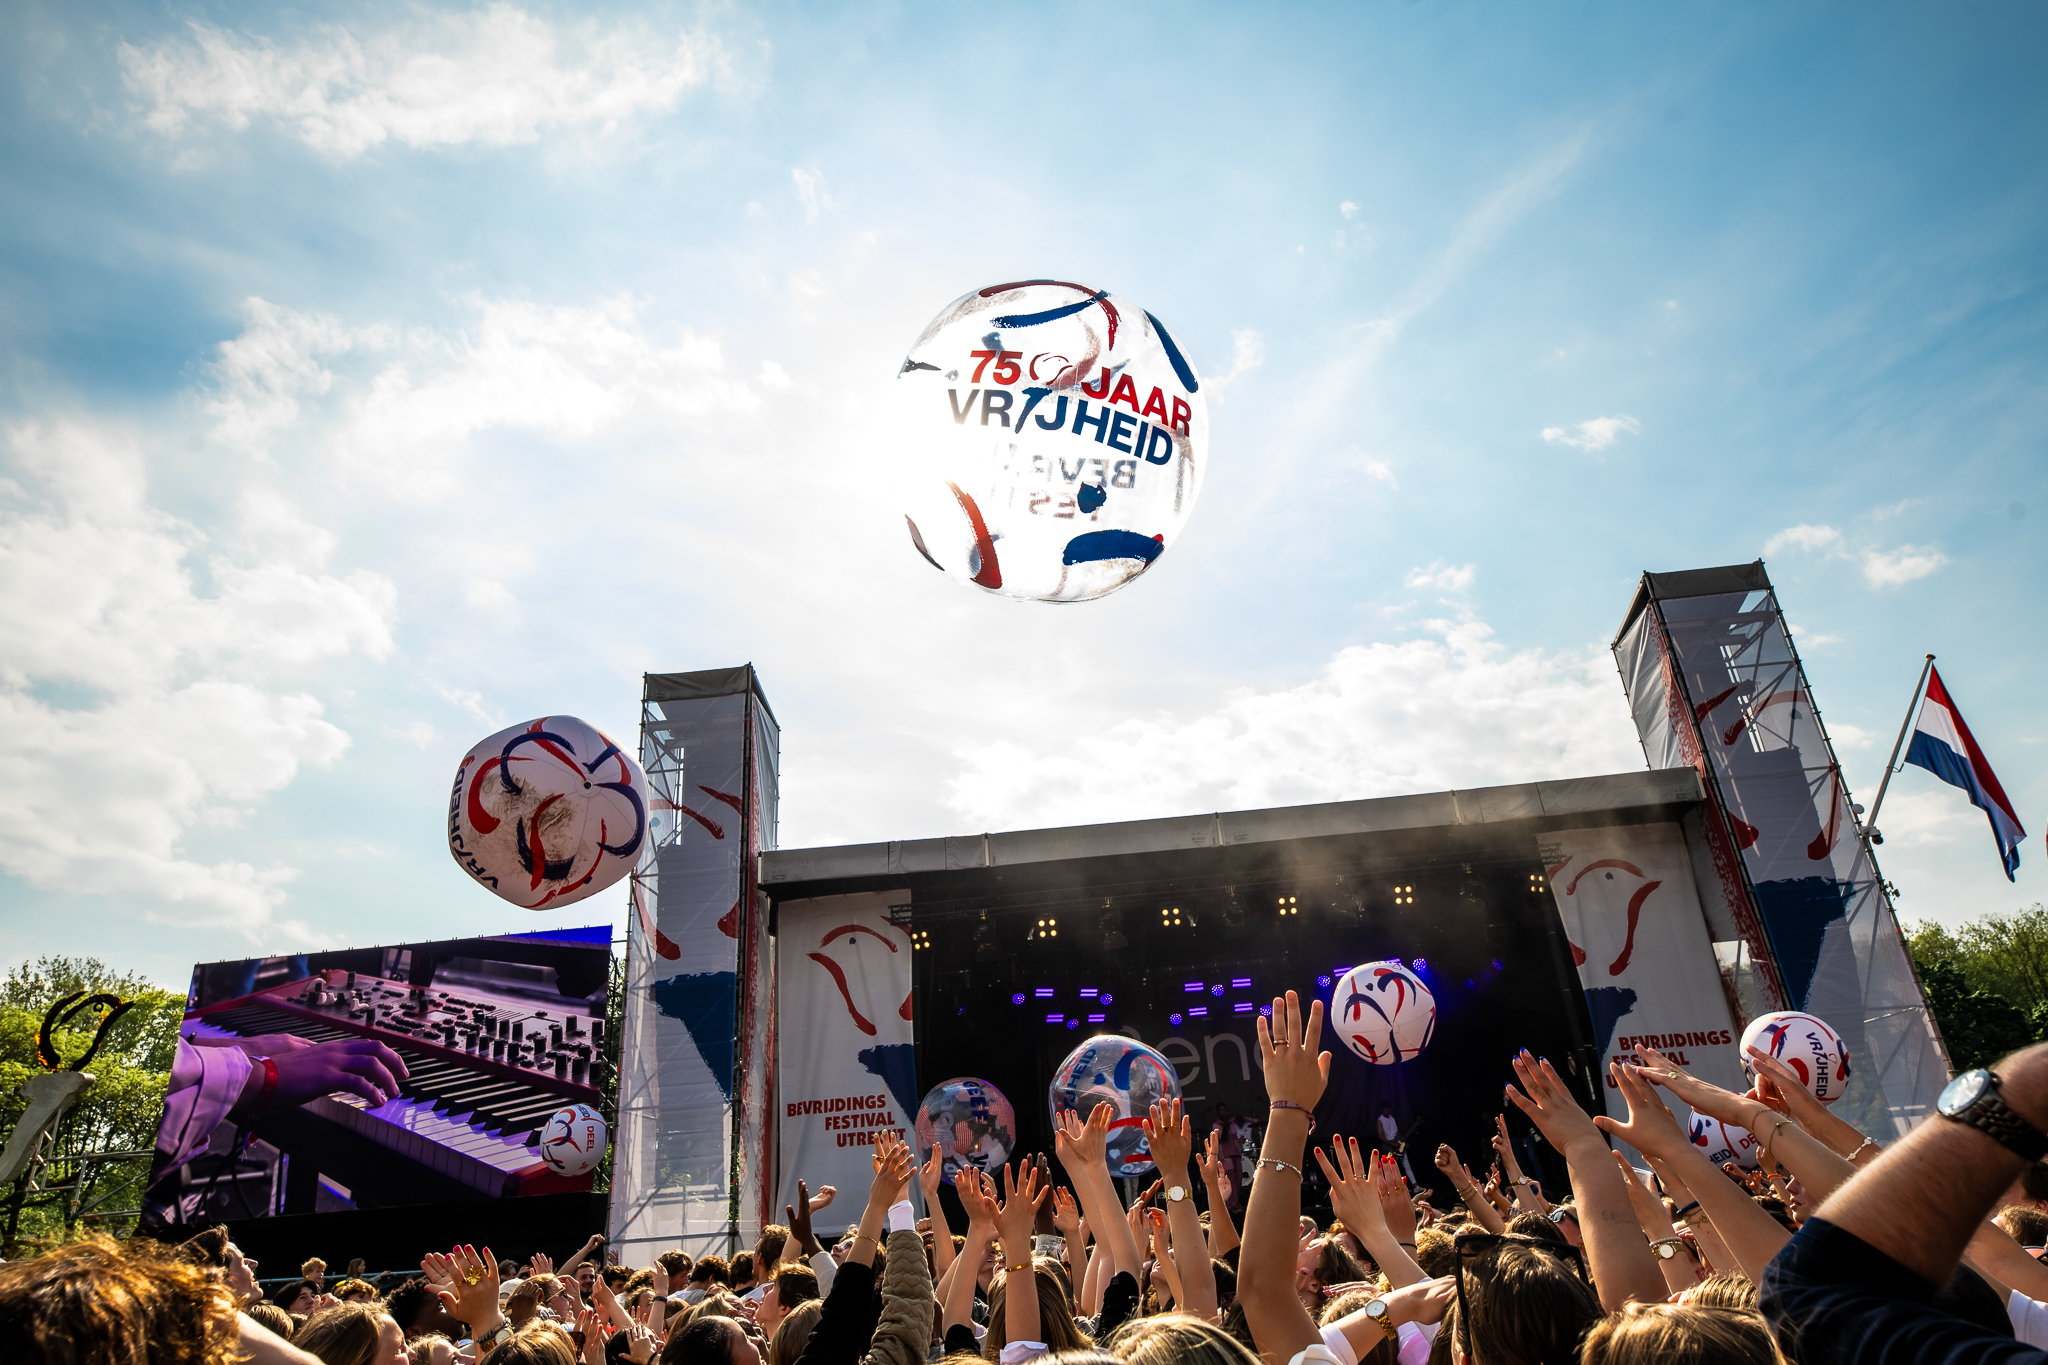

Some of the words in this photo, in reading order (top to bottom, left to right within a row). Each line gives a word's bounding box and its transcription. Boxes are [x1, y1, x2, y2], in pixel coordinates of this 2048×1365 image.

[969, 350, 1023, 385] 75
[1081, 366, 1192, 438] JAAR
[947, 387, 1174, 466] VRIJHEID
[450, 767, 499, 890] VRIJHEID
[1618, 1029, 1732, 1051] BEVRIJDINGS
[1805, 1031, 1829, 1098] VRIJHEID
[787, 1094, 886, 1117] BEVRIJDINGS
[825, 1111, 895, 1131] FESTIVAL
[586, 1125, 595, 1152] DEEL
[1739, 1133, 1757, 1150] DE
